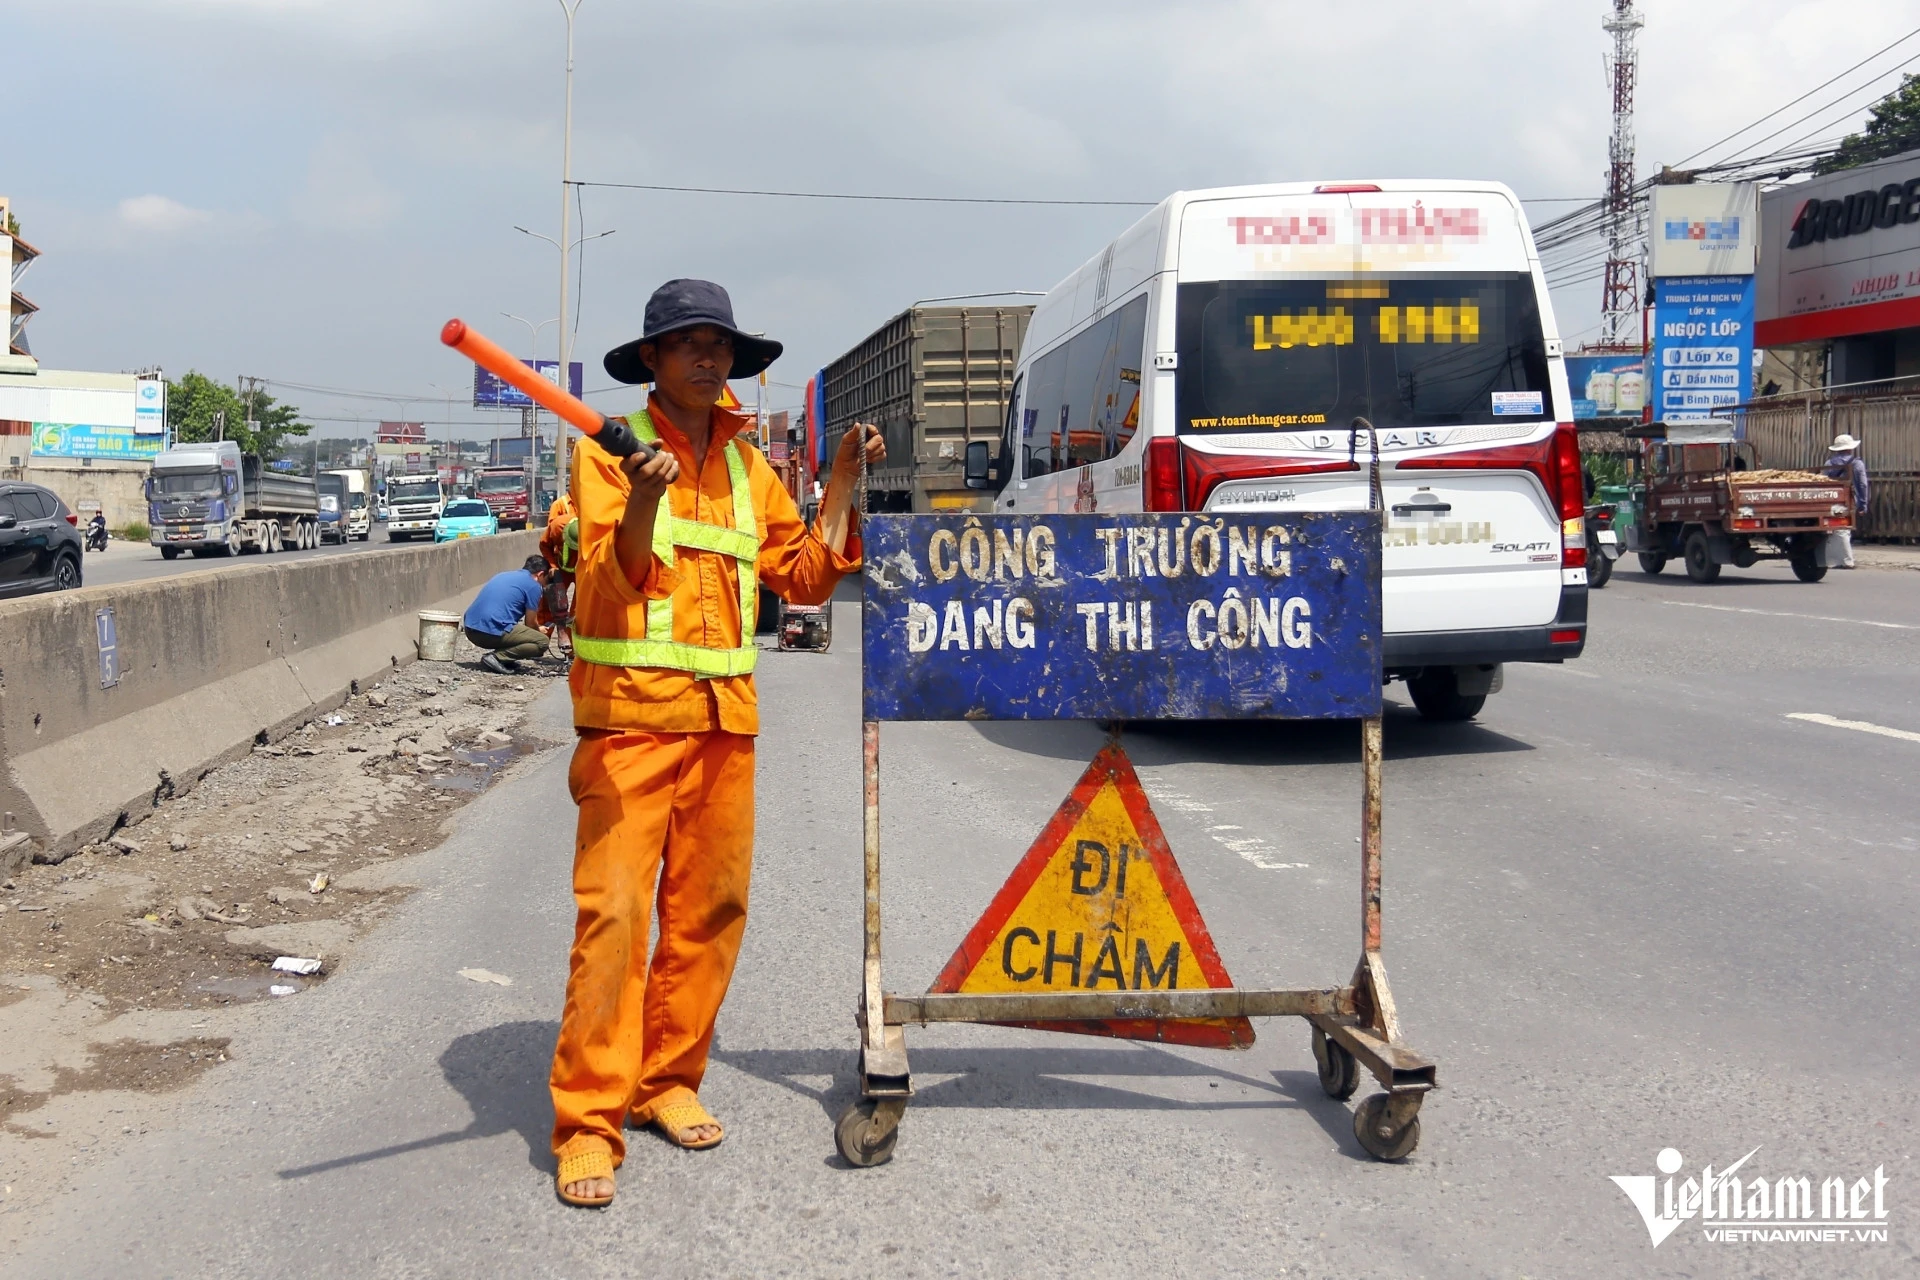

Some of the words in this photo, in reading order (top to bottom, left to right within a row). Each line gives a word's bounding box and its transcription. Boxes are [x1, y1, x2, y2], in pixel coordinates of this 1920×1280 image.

[1665, 295, 1690, 303] TRUNG
[1705, 307, 1716, 316] XE
[1663, 322, 1707, 339] NGỌC
[1711, 318, 1741, 336] LỐP
[1687, 350, 1711, 363] Lốp
[1716, 351, 1733, 362] Xe
[1709, 374, 1734, 384] Nhớt
[1687, 395, 1710, 404] Bình
[1190, 413, 1326, 428] www.toanthangcar.com
[1220, 489, 1296, 504] HYUNDAI
[928, 516, 1056, 581] CÔNG
[1095, 516, 1292, 579] TRƯỜNG
[1490, 542, 1551, 553] SOLATI
[1077, 600, 1152, 652] THI
[1186, 587, 1312, 650] CÔNG
[101, 615, 108, 641] 7
[105, 655, 112, 681] 5
[1070, 839, 1128, 899] ĐI
